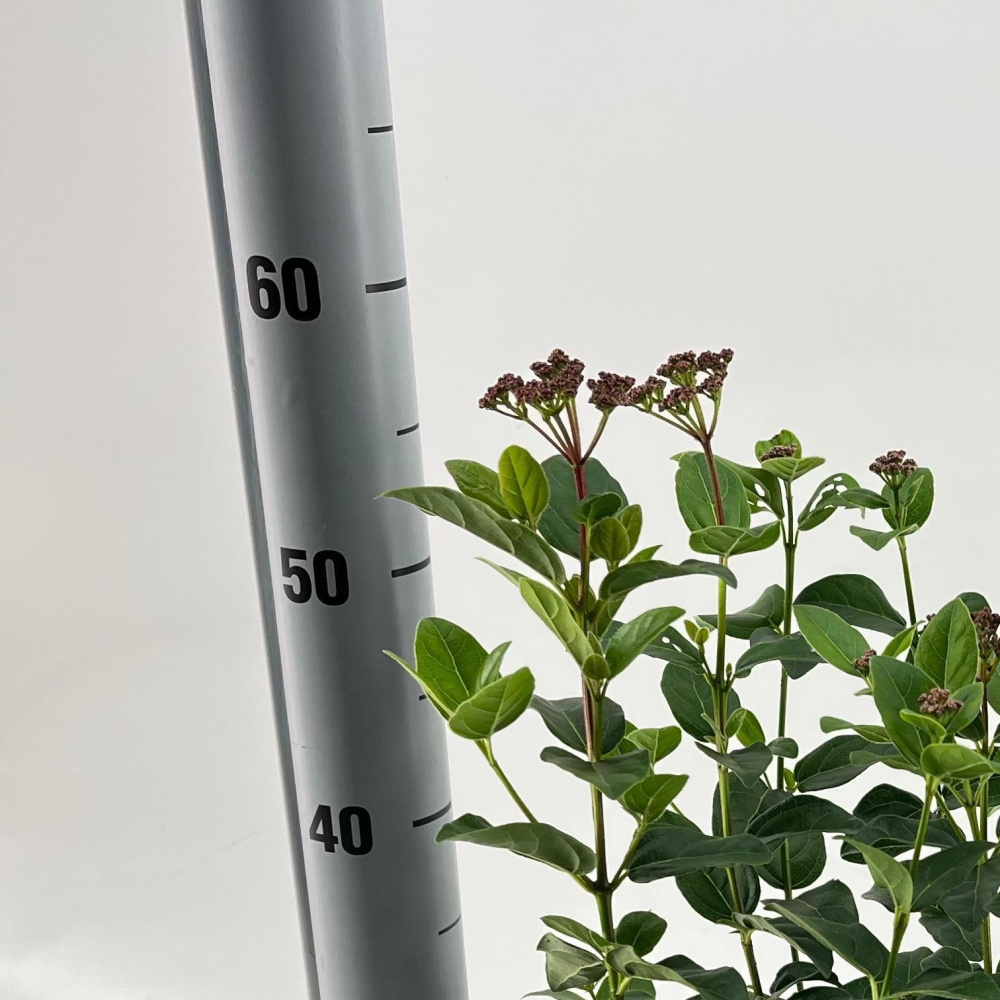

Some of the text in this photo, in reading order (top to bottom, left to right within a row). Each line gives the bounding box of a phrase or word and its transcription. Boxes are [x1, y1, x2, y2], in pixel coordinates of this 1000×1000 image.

[246, 255, 322, 323] 60
[280, 547, 349, 606] 50
[310, 804, 373, 855] 40
